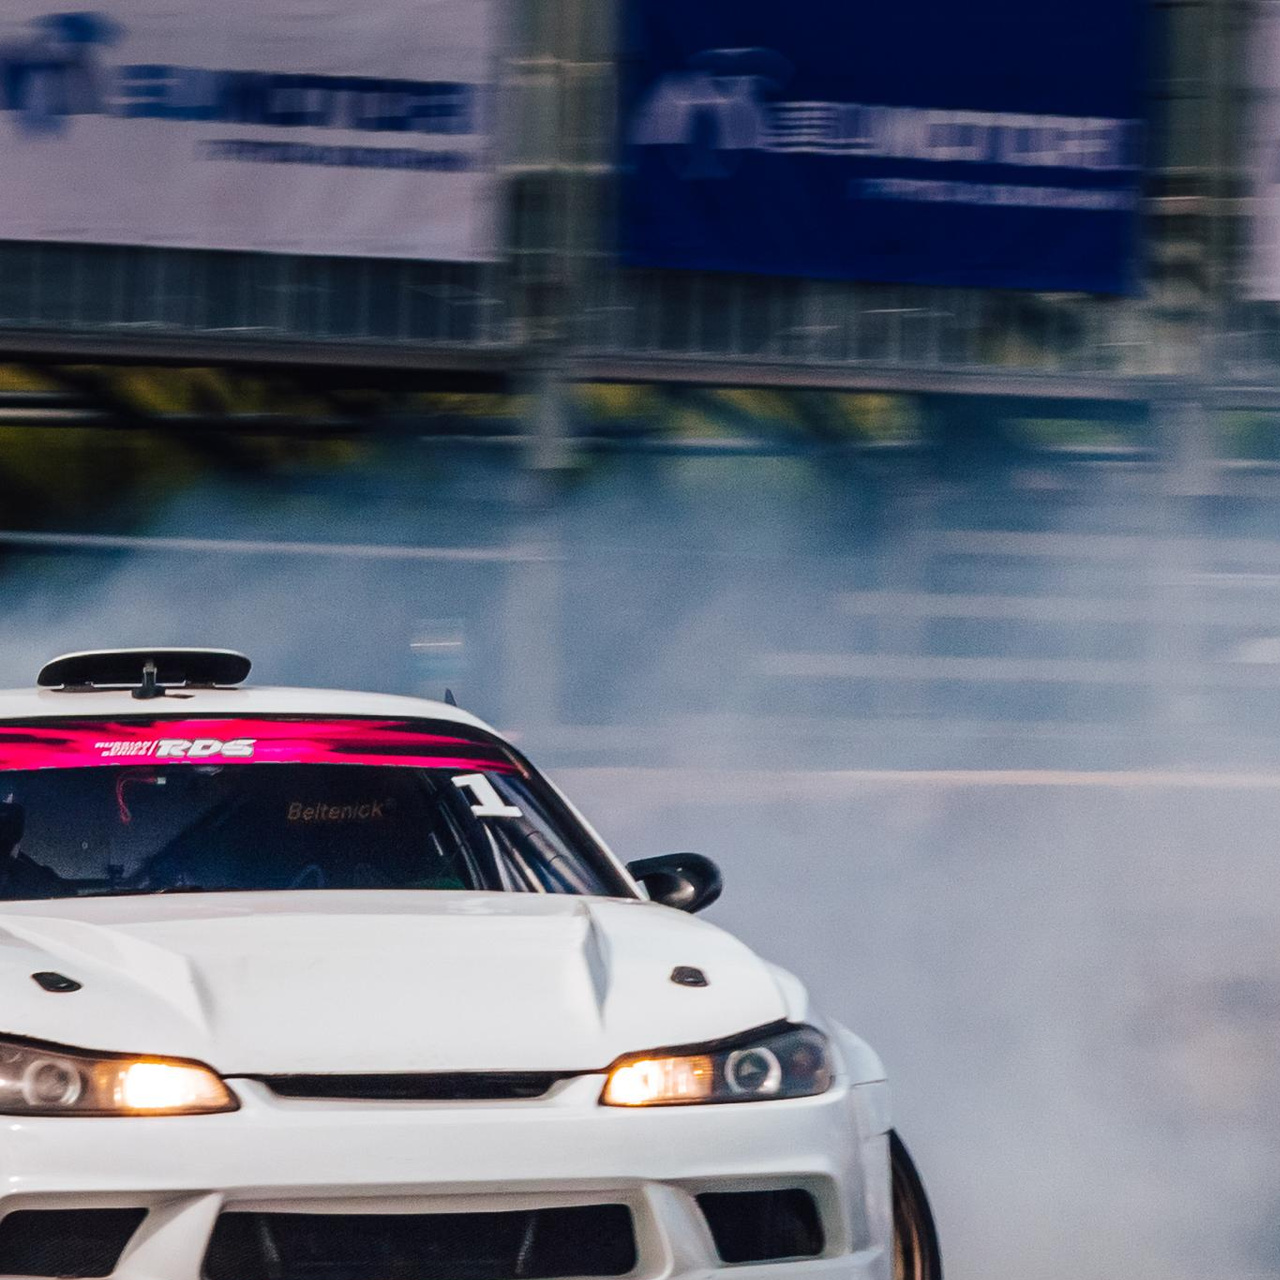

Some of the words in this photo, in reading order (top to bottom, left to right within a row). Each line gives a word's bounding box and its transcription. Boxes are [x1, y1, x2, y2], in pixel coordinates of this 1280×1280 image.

[155, 738, 257, 758] RDS
[451, 773, 523, 818] 1
[287, 801, 384, 820] Beltenick
